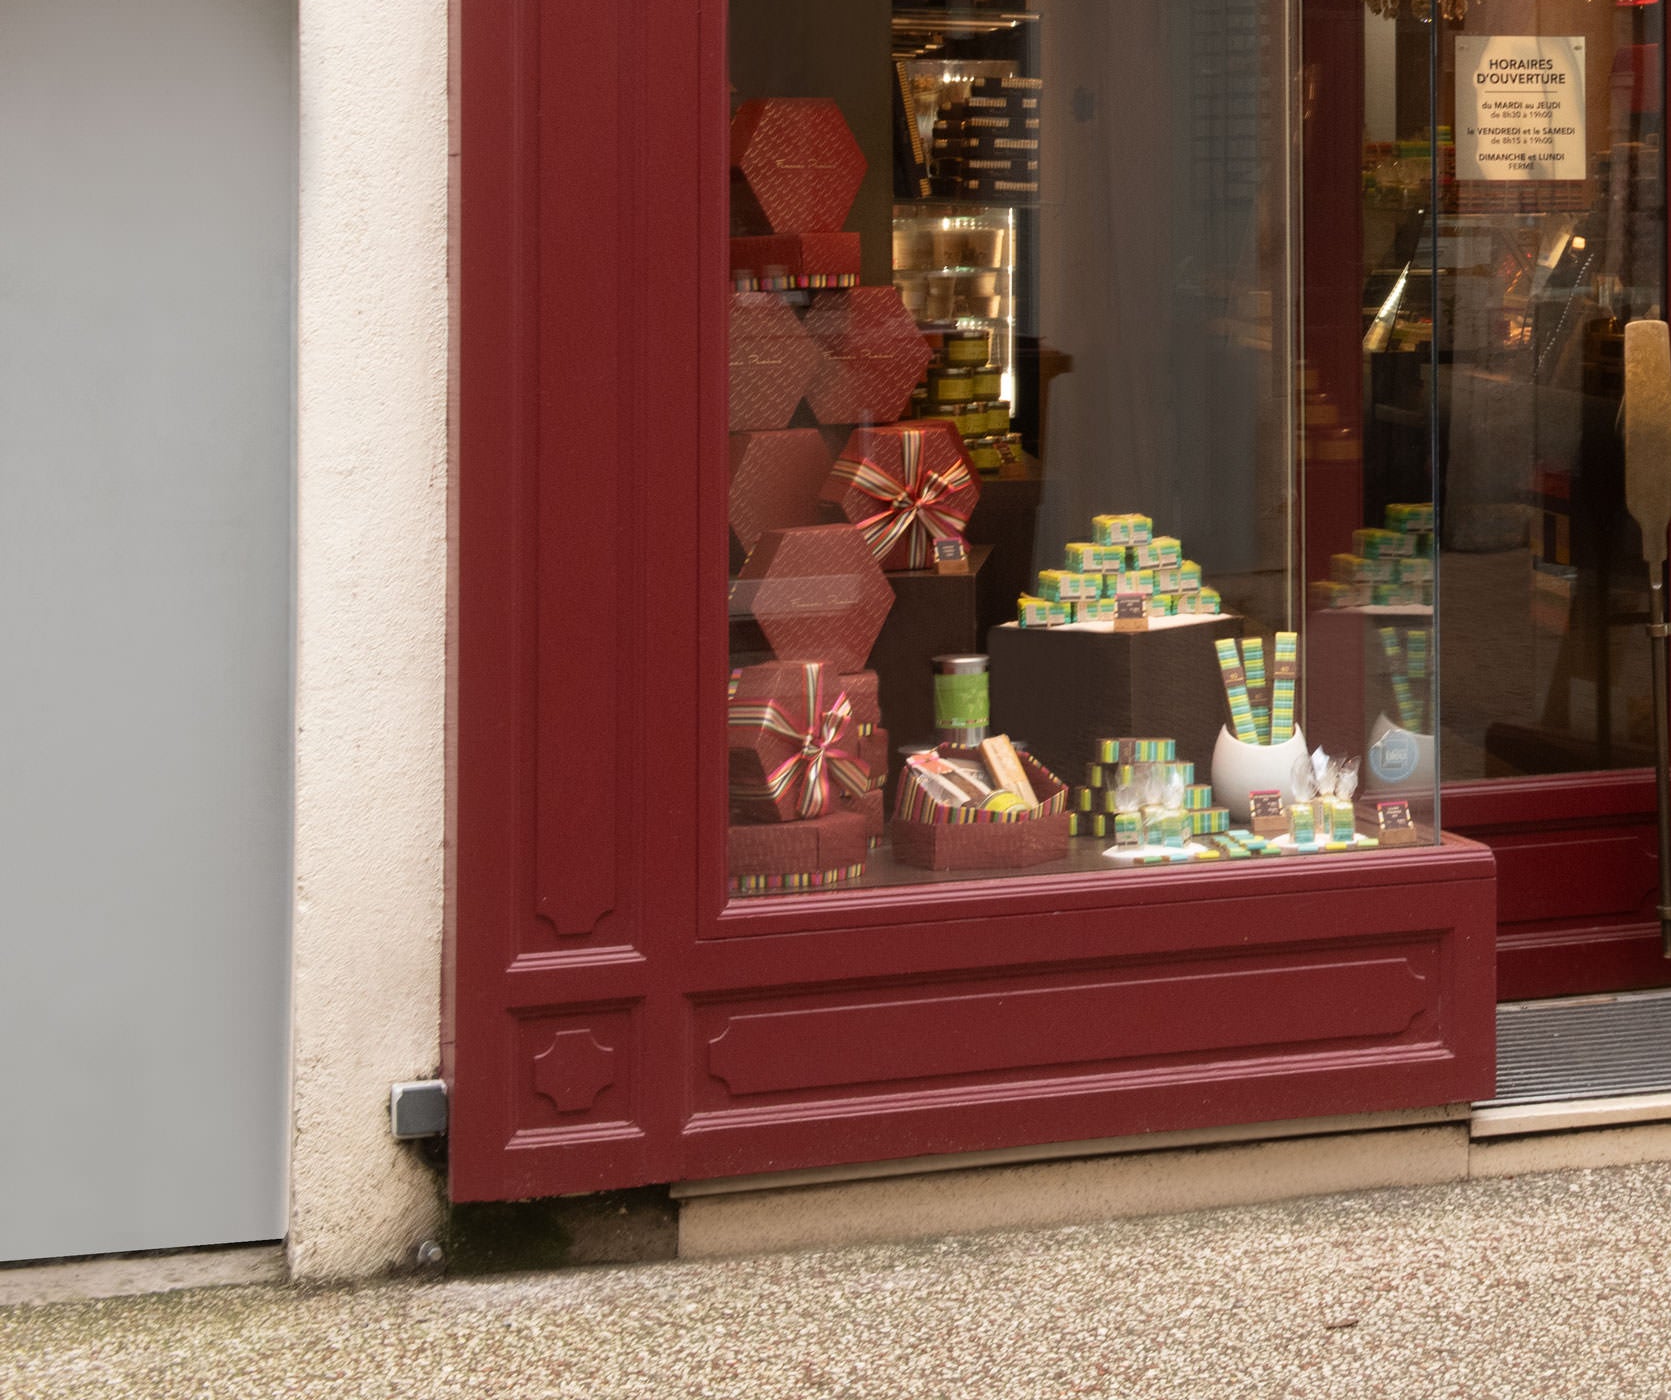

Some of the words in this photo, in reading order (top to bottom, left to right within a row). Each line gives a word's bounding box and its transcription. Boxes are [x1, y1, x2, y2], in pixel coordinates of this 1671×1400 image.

[1489, 59, 1553, 70] HORAIRES
[1476, 73, 1566, 84] D'OUVERTURE
[1482, 101, 1492, 109] du
[1494, 101, 1522, 109] MARDI
[1536, 101, 1560, 109] JEUDI
[1478, 127, 1521, 135] VENDREDI
[1523, 127, 1531, 135] et
[1543, 127, 1575, 135] SAMEDI
[1478, 153, 1526, 161] DIMANCHE
[1539, 153, 1565, 161] LUNDI
